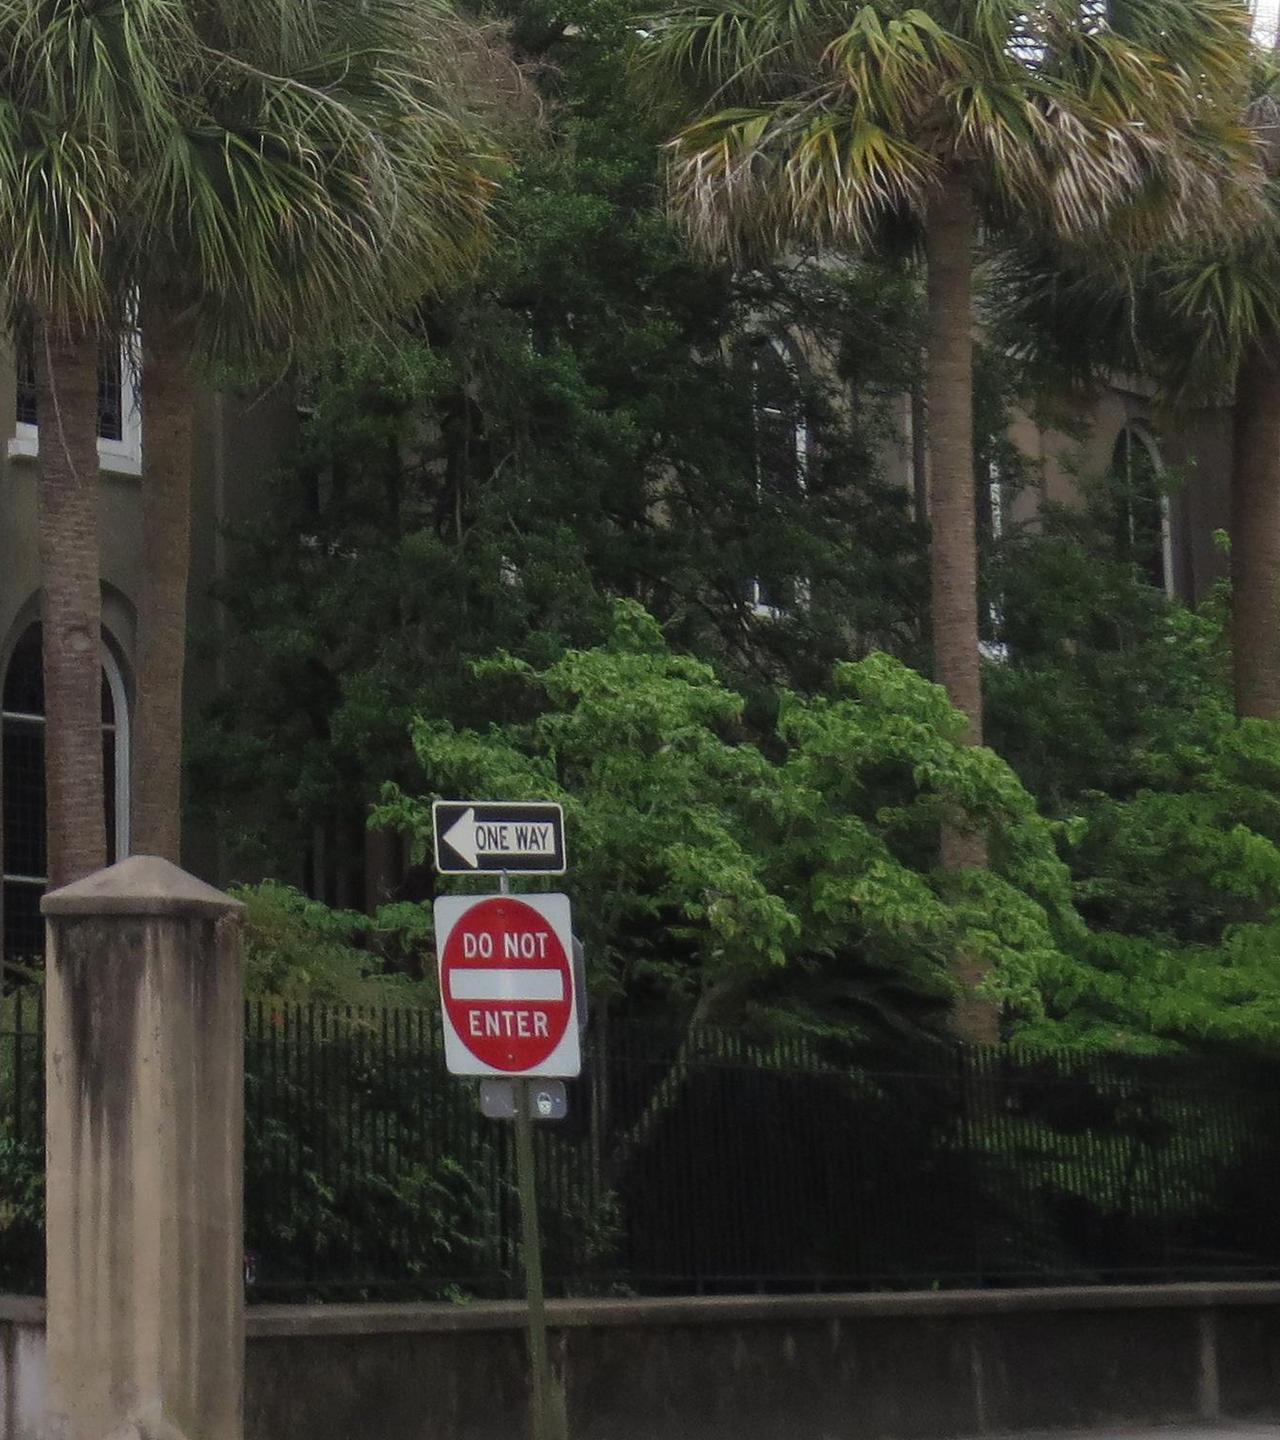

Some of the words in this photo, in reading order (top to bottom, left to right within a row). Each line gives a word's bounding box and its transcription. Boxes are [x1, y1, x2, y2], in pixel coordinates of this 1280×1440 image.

[476, 825, 510, 850] ONE
[515, 825, 549, 850] WAY
[462, 933, 493, 959] DO
[504, 932, 549, 958] NOT
[468, 1010, 550, 1038] ENTER
